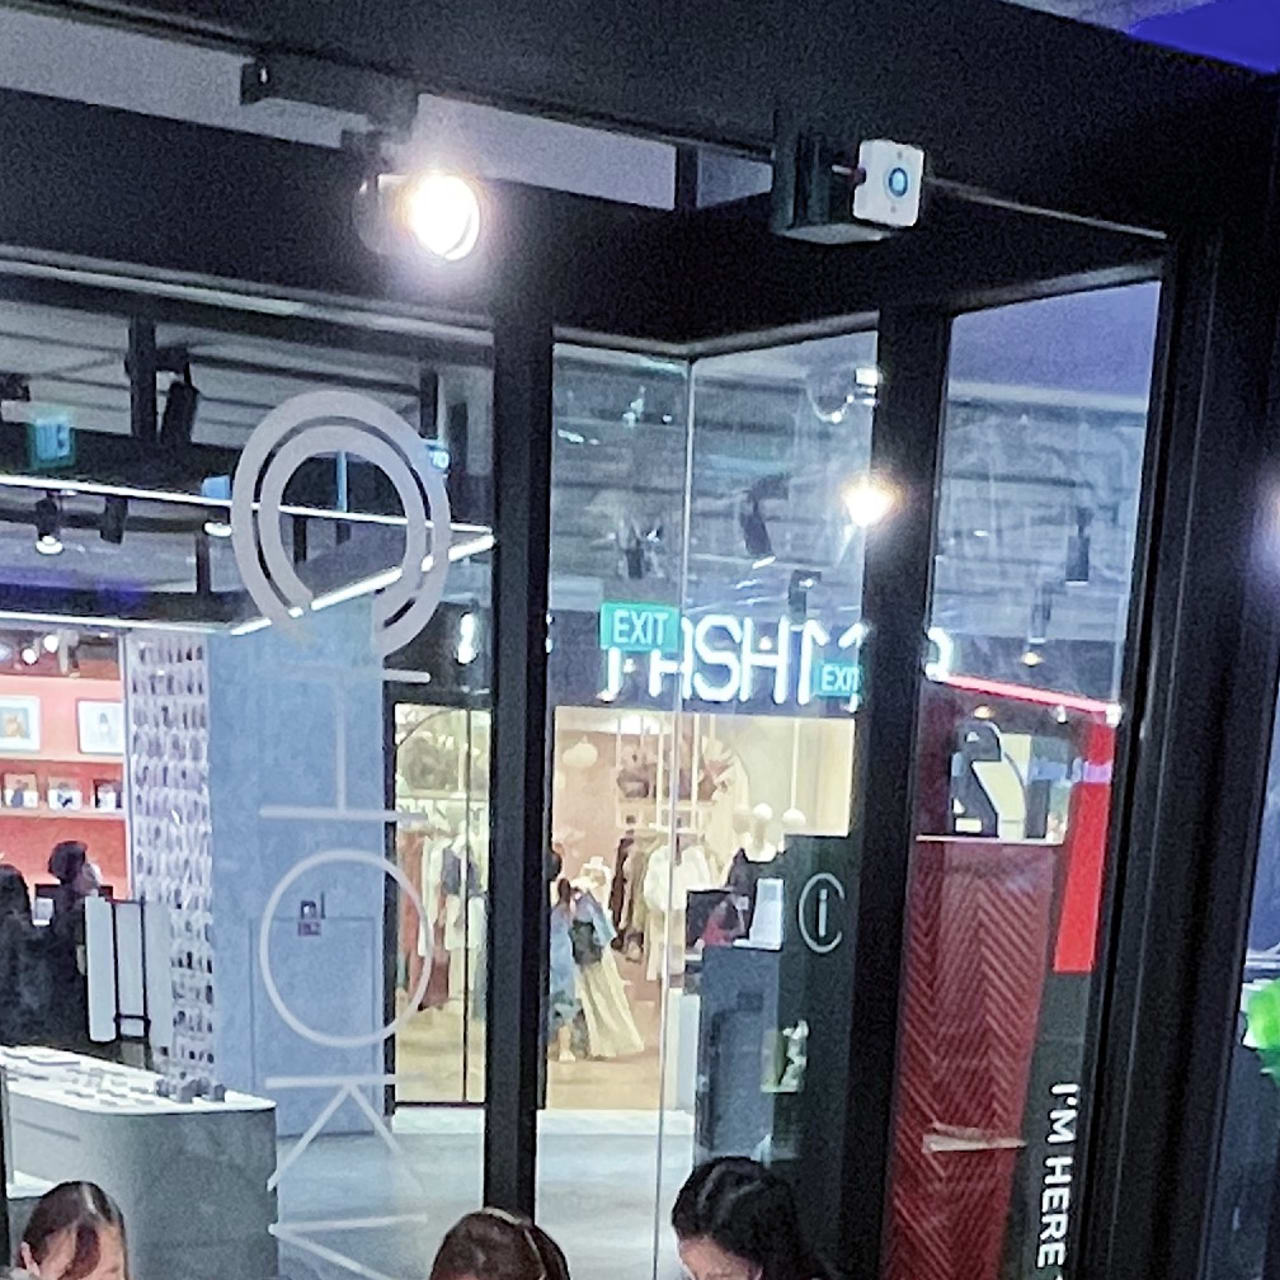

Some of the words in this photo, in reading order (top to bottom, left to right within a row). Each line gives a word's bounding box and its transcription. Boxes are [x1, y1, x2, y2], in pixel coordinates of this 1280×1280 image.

[613, 608, 669, 646] EXIT
[821, 663, 860, 692] EXIT
[1046, 1082, 1081, 1144] I'M
[1036, 1155, 1074, 1268] HERE
